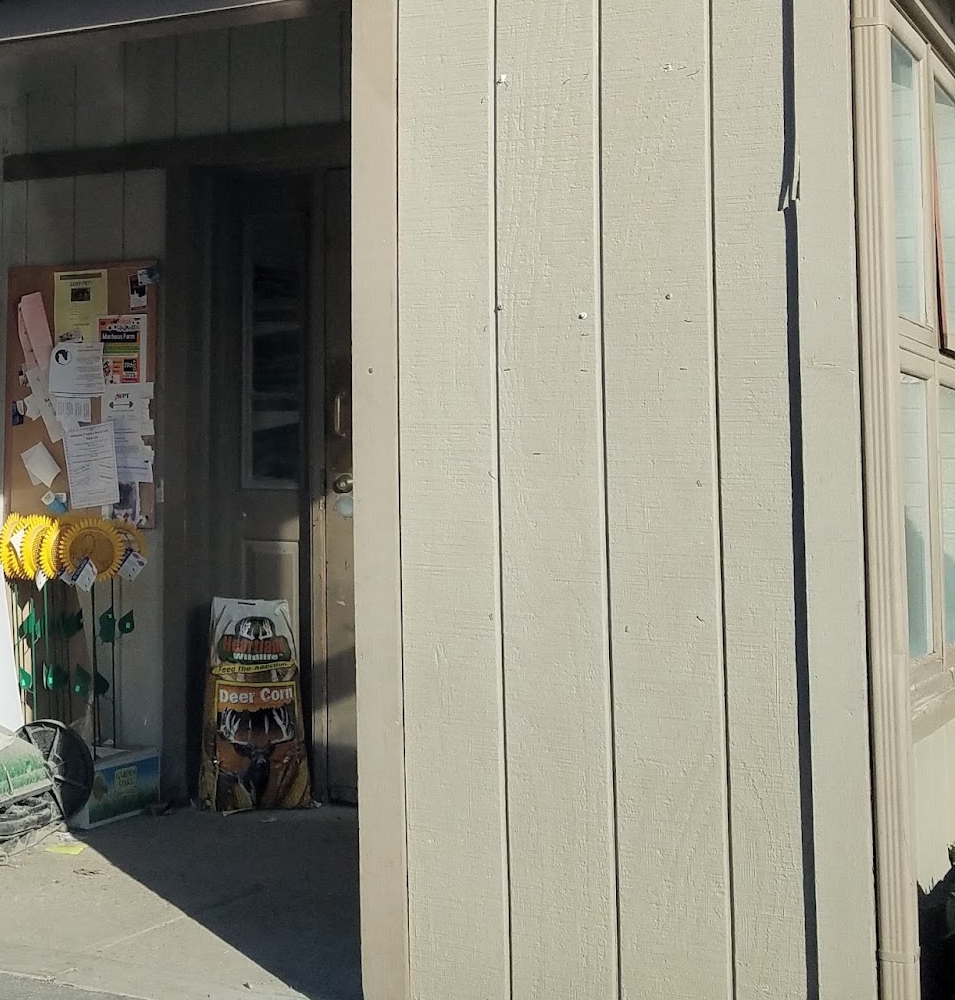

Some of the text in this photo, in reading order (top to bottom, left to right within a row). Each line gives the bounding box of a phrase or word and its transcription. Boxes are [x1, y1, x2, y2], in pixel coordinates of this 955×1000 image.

[218, 664, 236, 673] Feed
[219, 688, 293, 704] Deer Corn
